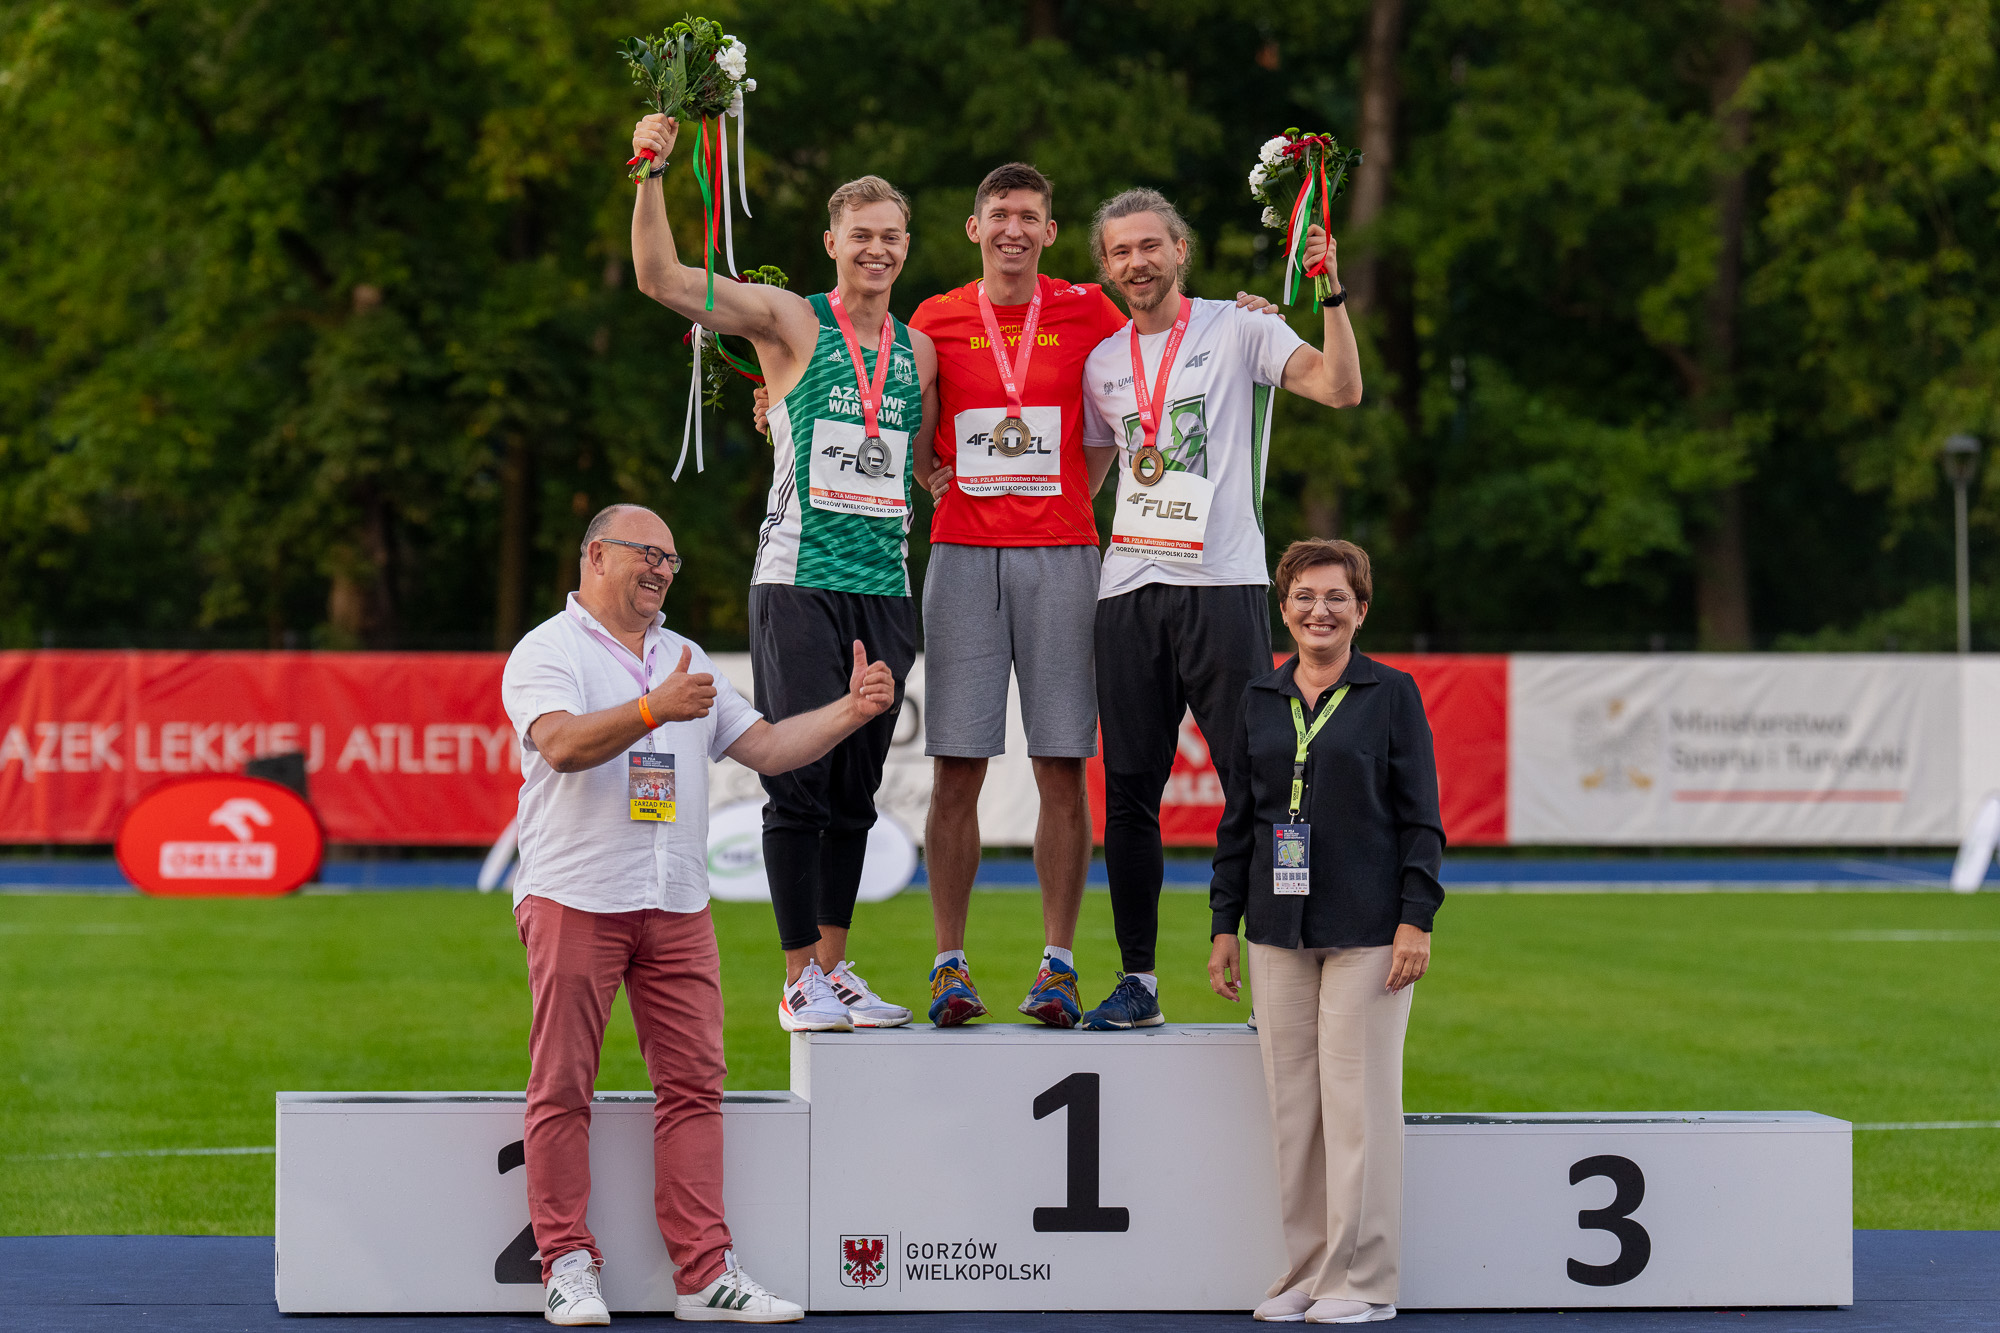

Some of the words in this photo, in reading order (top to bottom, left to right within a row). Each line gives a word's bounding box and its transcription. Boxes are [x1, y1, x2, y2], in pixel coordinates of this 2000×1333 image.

[966, 432, 989, 446] 4F
[821, 445, 845, 458] 4F
[830, 491, 844, 499] PZLA
[813, 498, 841, 508] GORZÓW
[842, 502, 887, 513] WIELKOPOLSKI
[1126, 492, 1148, 505] 4F
[1141, 498, 1199, 522] FUEL
[1131, 537, 1144, 545] PZLA
[1144, 538, 1175, 547] Mistrzostwa
[1175, 541, 1192, 549] Polski
[1115, 546, 1141, 555] GORZÓW
[1141, 548, 1183, 558] WIELKOPOLSKI
[1183, 551, 1199, 559] 2023
[1033, 1072, 1129, 1232] 1
[1567, 1154, 1651, 1286] 3
[907, 1238, 998, 1260] GORZÓW
[905, 1264, 1051, 1280] WIELKOPOLSKI
